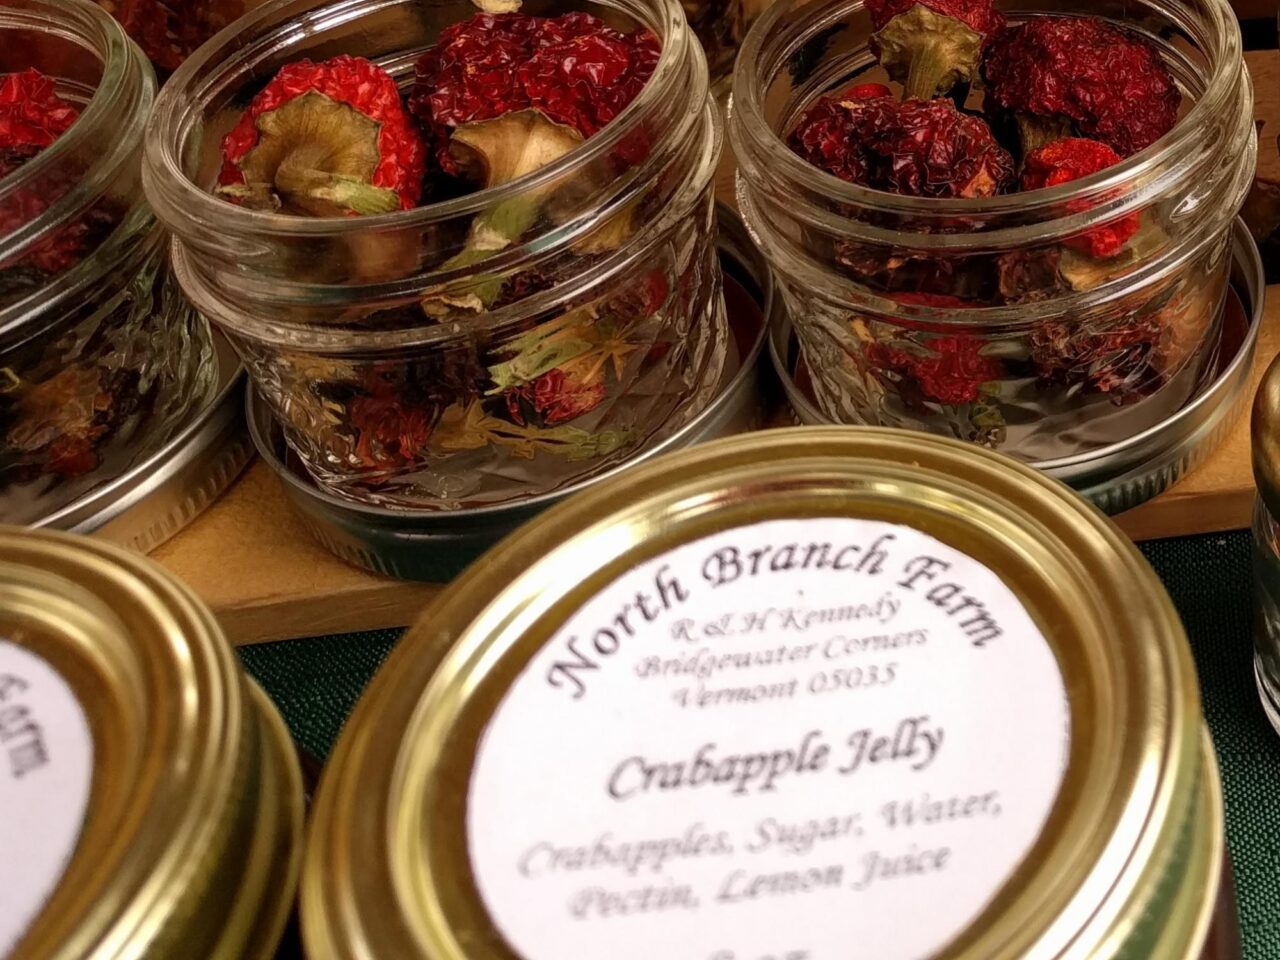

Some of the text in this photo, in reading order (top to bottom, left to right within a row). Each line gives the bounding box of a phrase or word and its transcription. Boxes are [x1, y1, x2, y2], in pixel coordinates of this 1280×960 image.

[547, 533, 1005, 699] North Branch Farm
[671, 618, 698, 641] R
[740, 607, 776, 633] H
[780, 591, 901, 631] Kennedy
[635, 628, 929, 680] Bridgewater Corners
[673, 661, 899, 708] Vermont 05035
[606, 715, 944, 800] Crabapple Jelly
[516, 790, 1002, 878] Crabapples, Sugar, Water,
[714, 870, 844, 903] Lemon
[852, 843, 952, 891] Juice
